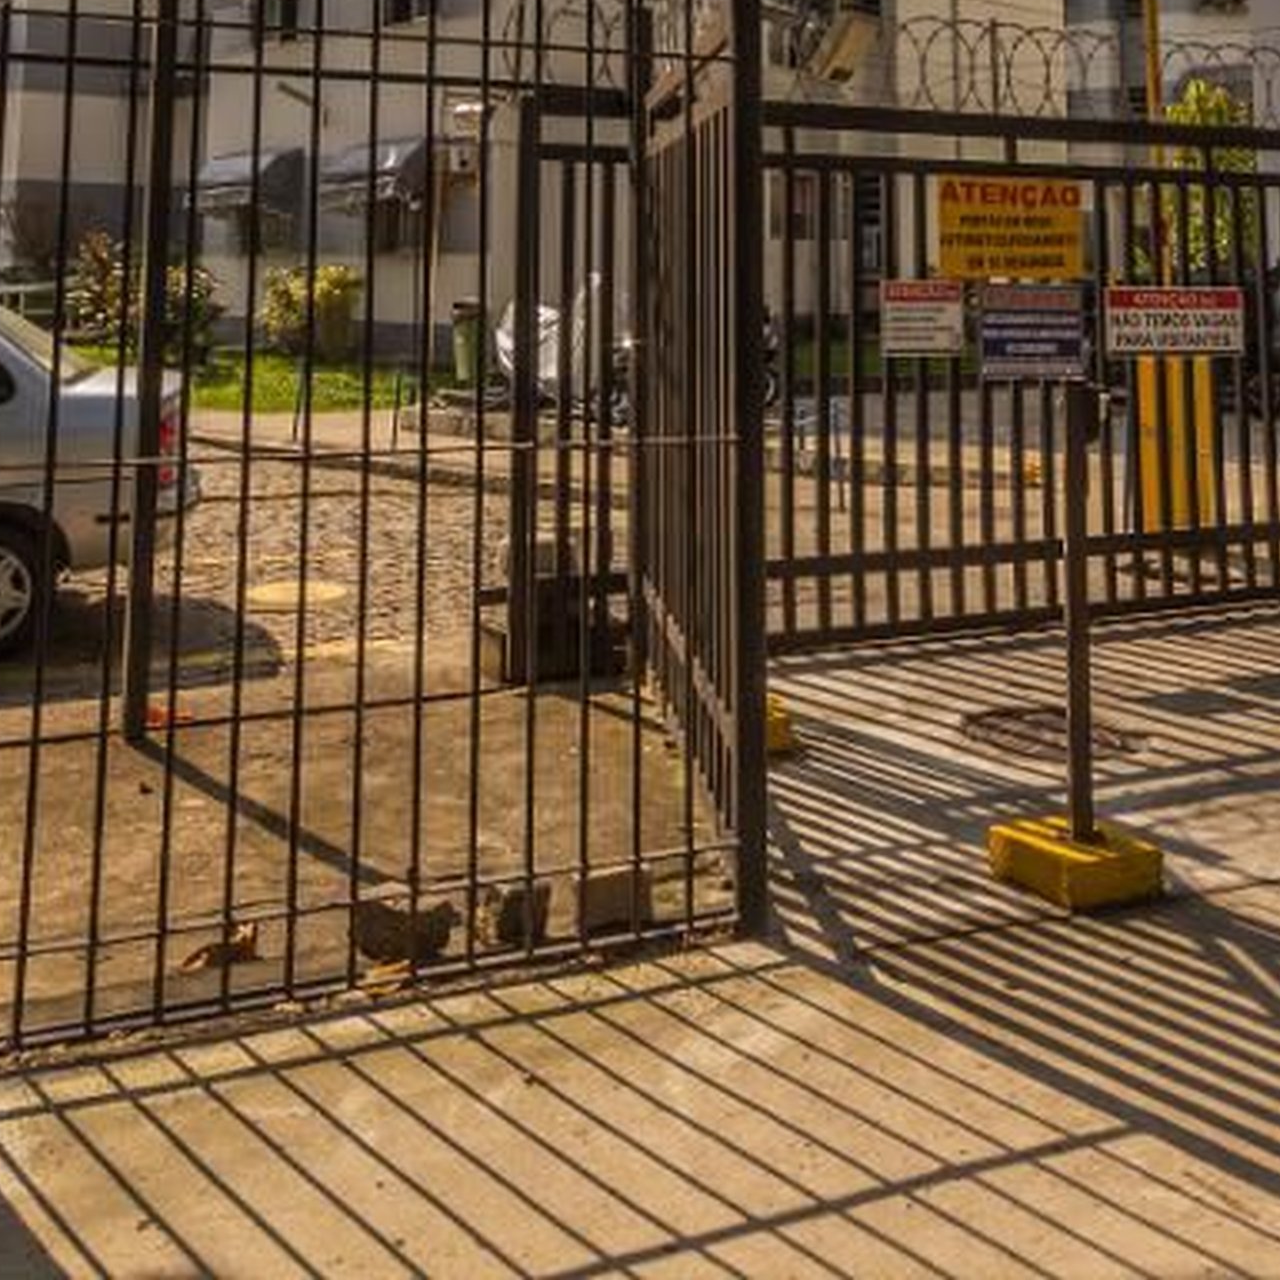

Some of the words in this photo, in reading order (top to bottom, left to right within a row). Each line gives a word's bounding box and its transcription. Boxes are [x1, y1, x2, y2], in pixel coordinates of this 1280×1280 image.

[1111, 312, 1142, 329] NÃO
[1145, 312, 1190, 330] TEMOS
[1192, 312, 1238, 329] VAGAS
[1115, 332, 1152, 348] PARA
[1154, 332, 1232, 348] VISITANTES
